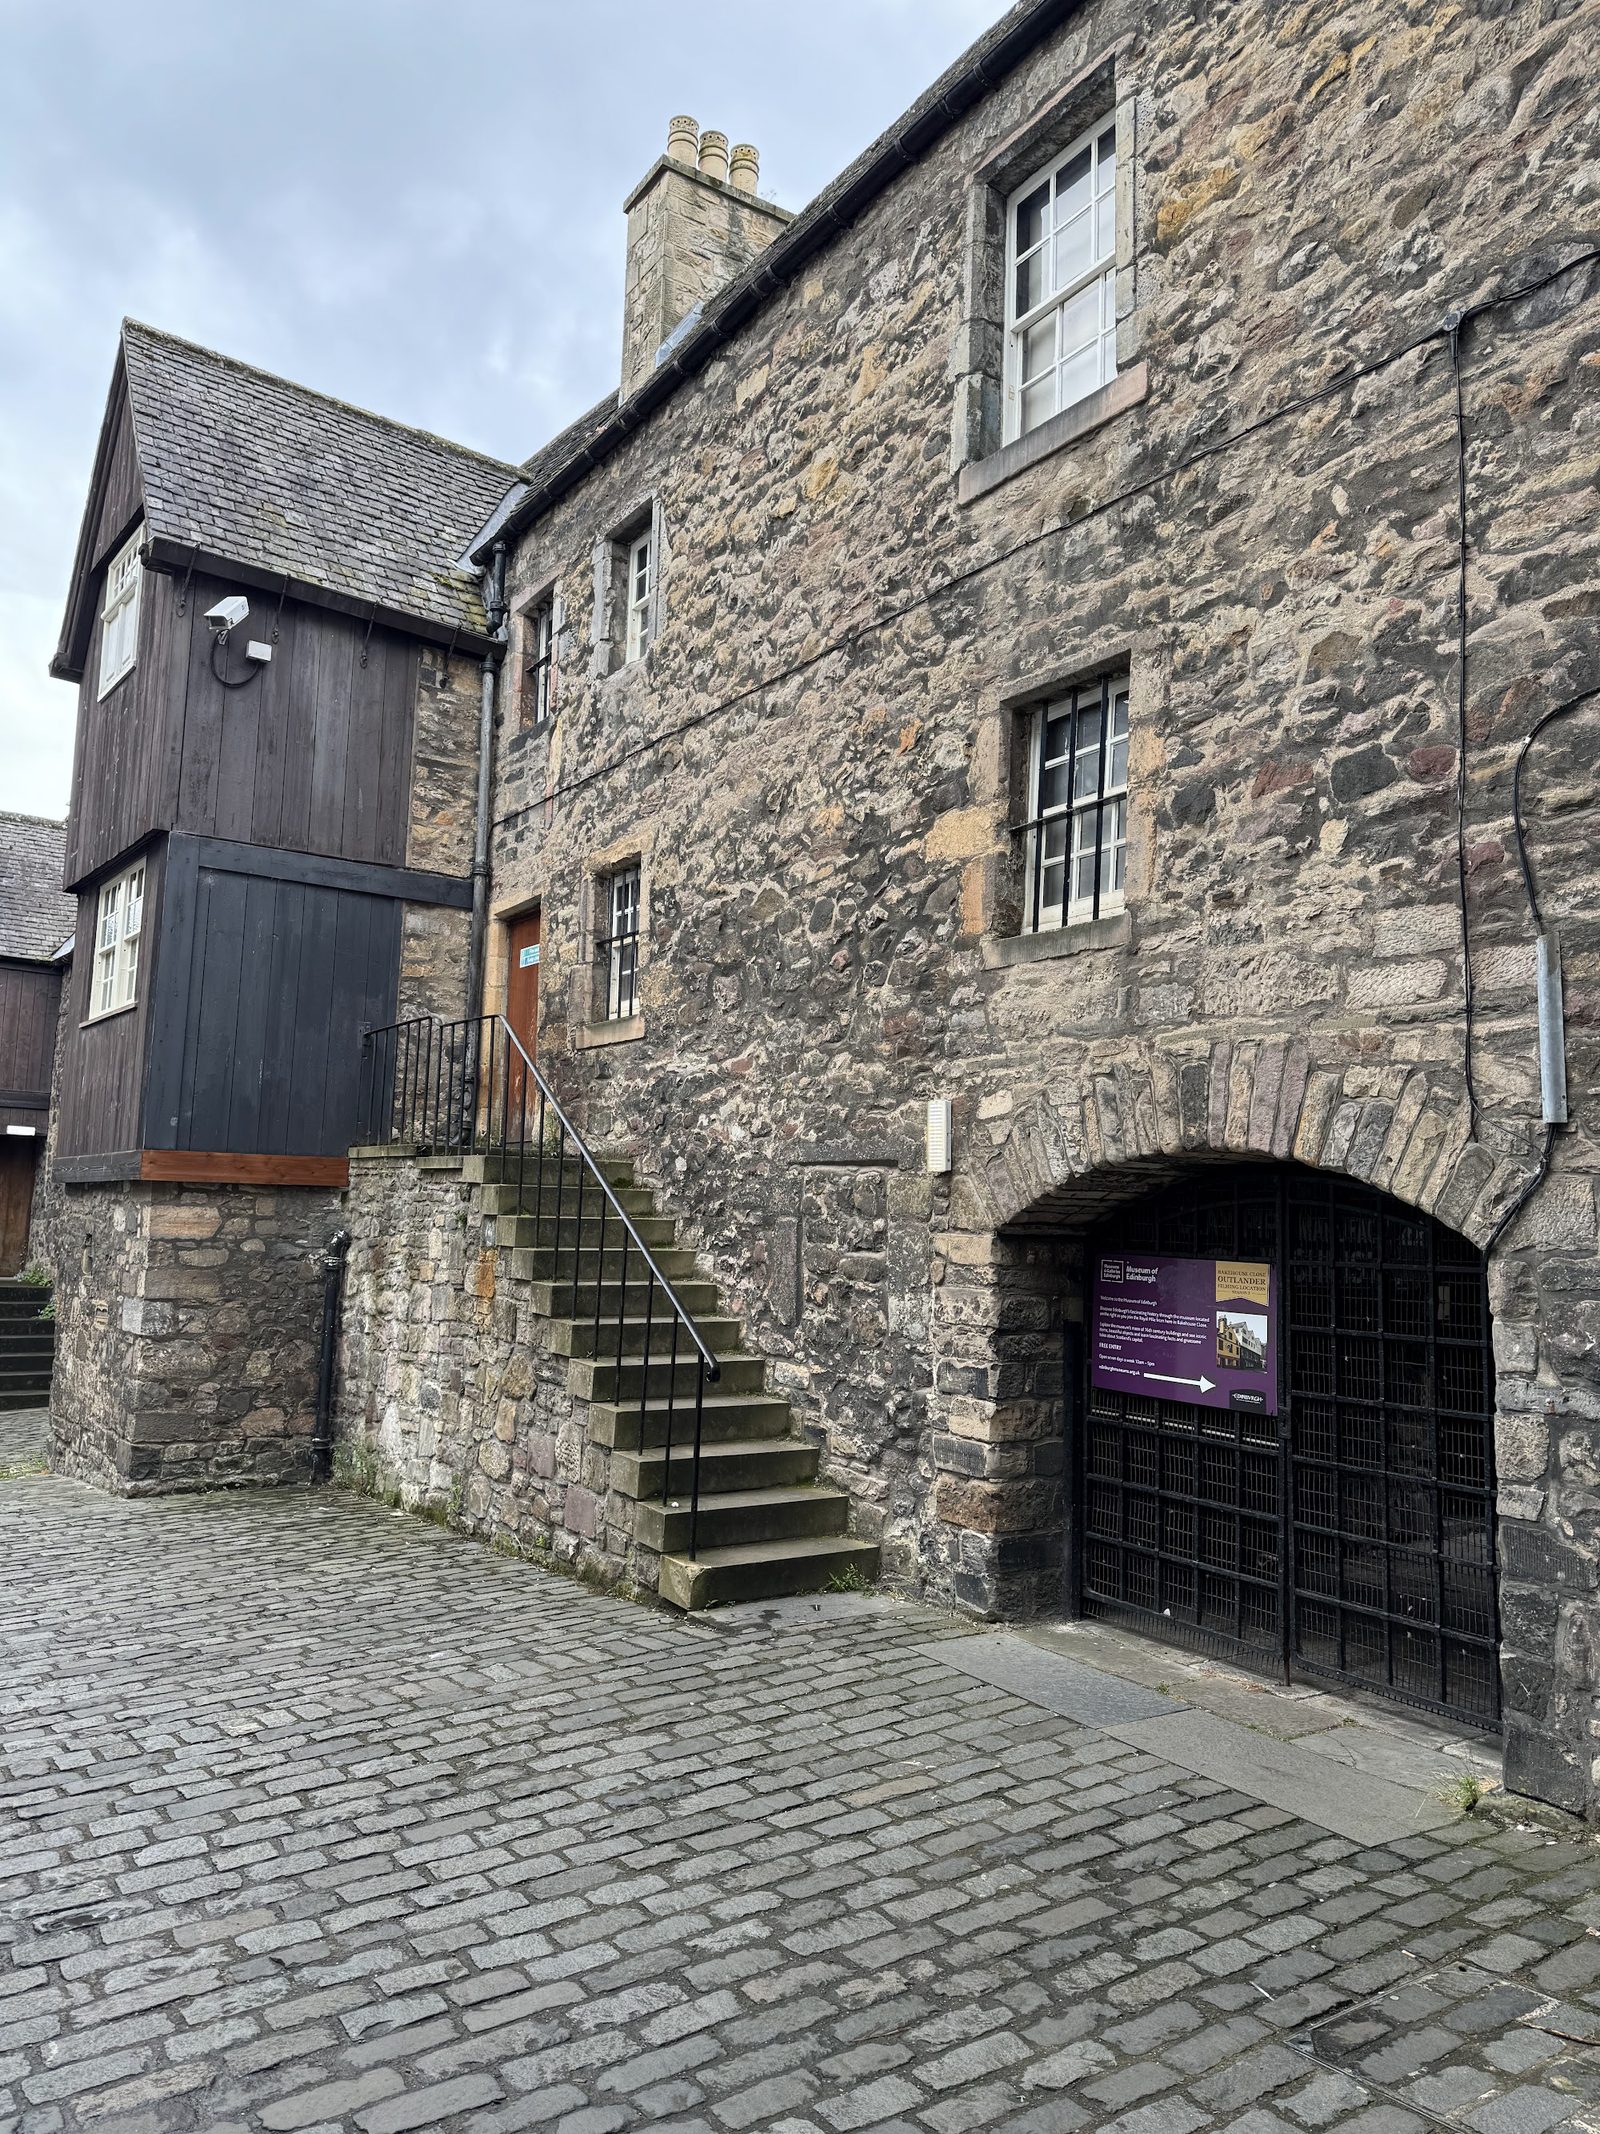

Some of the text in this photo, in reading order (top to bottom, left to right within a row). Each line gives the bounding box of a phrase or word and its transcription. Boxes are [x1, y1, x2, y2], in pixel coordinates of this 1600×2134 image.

[1126, 1266, 1150, 1274] Museum
[1126, 1273, 1156, 1283] Edinburgh
[1217, 1275, 1266, 1285] OUTLANDER
